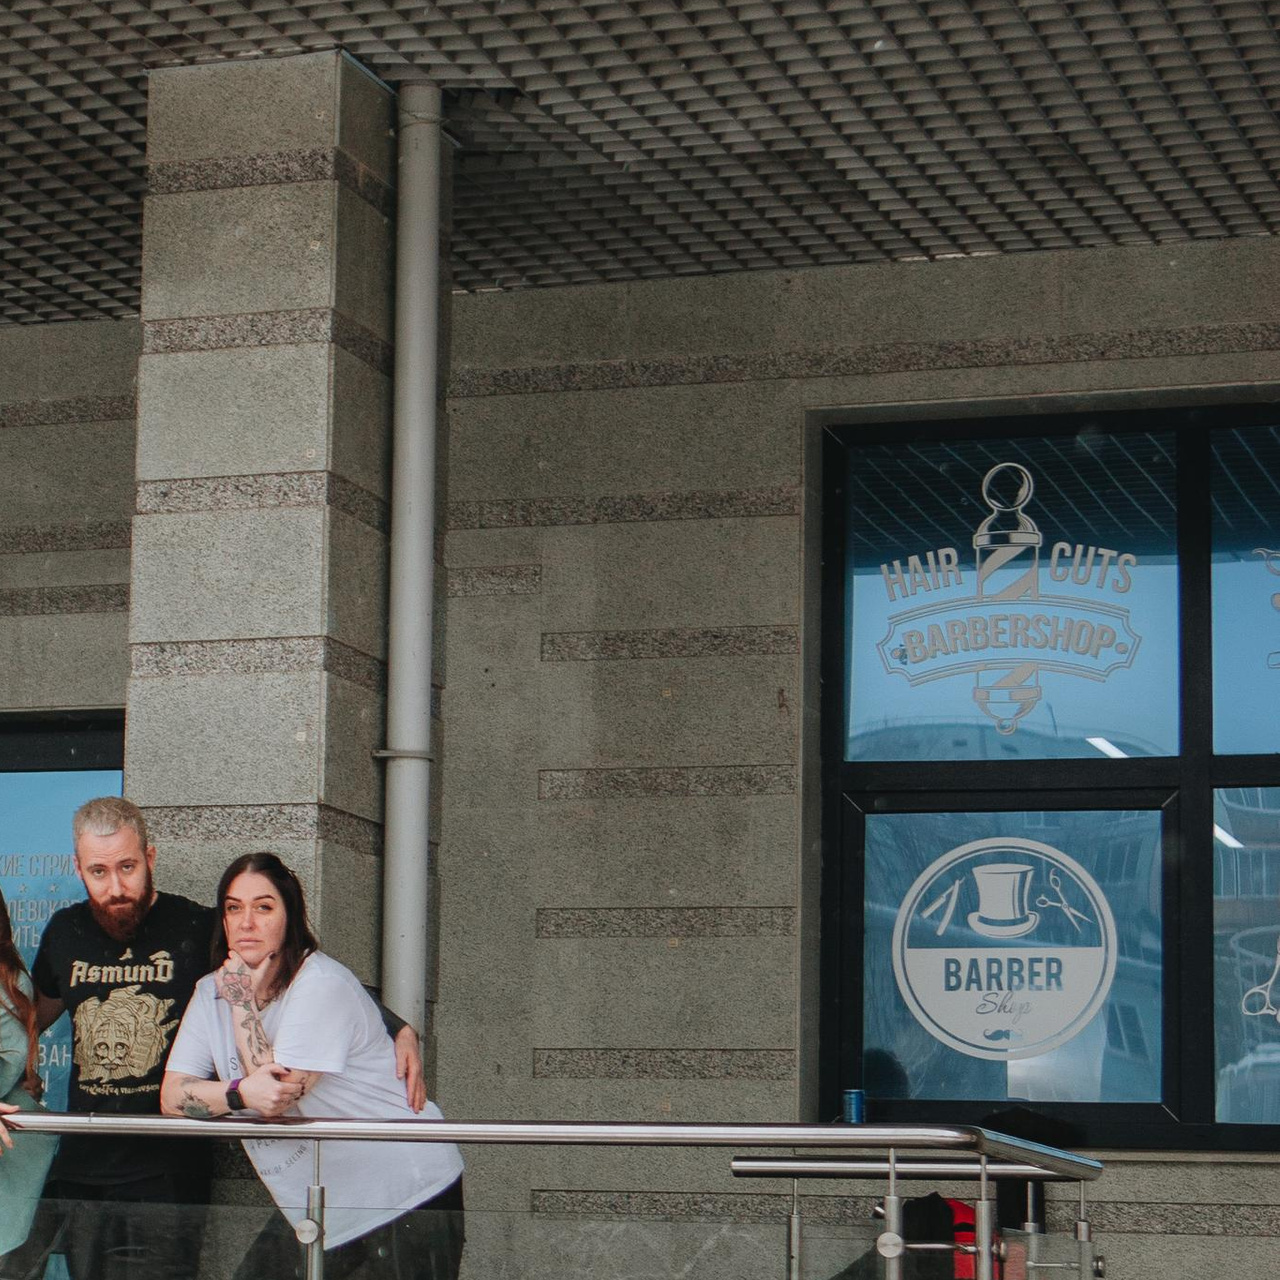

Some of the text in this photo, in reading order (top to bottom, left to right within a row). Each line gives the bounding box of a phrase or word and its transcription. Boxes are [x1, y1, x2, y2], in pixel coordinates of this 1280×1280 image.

[880, 541, 1138, 602] HAIR CUTS
[901, 613, 1117, 665] BARBERSHOP
[944, 957, 1064, 992] BARBER
